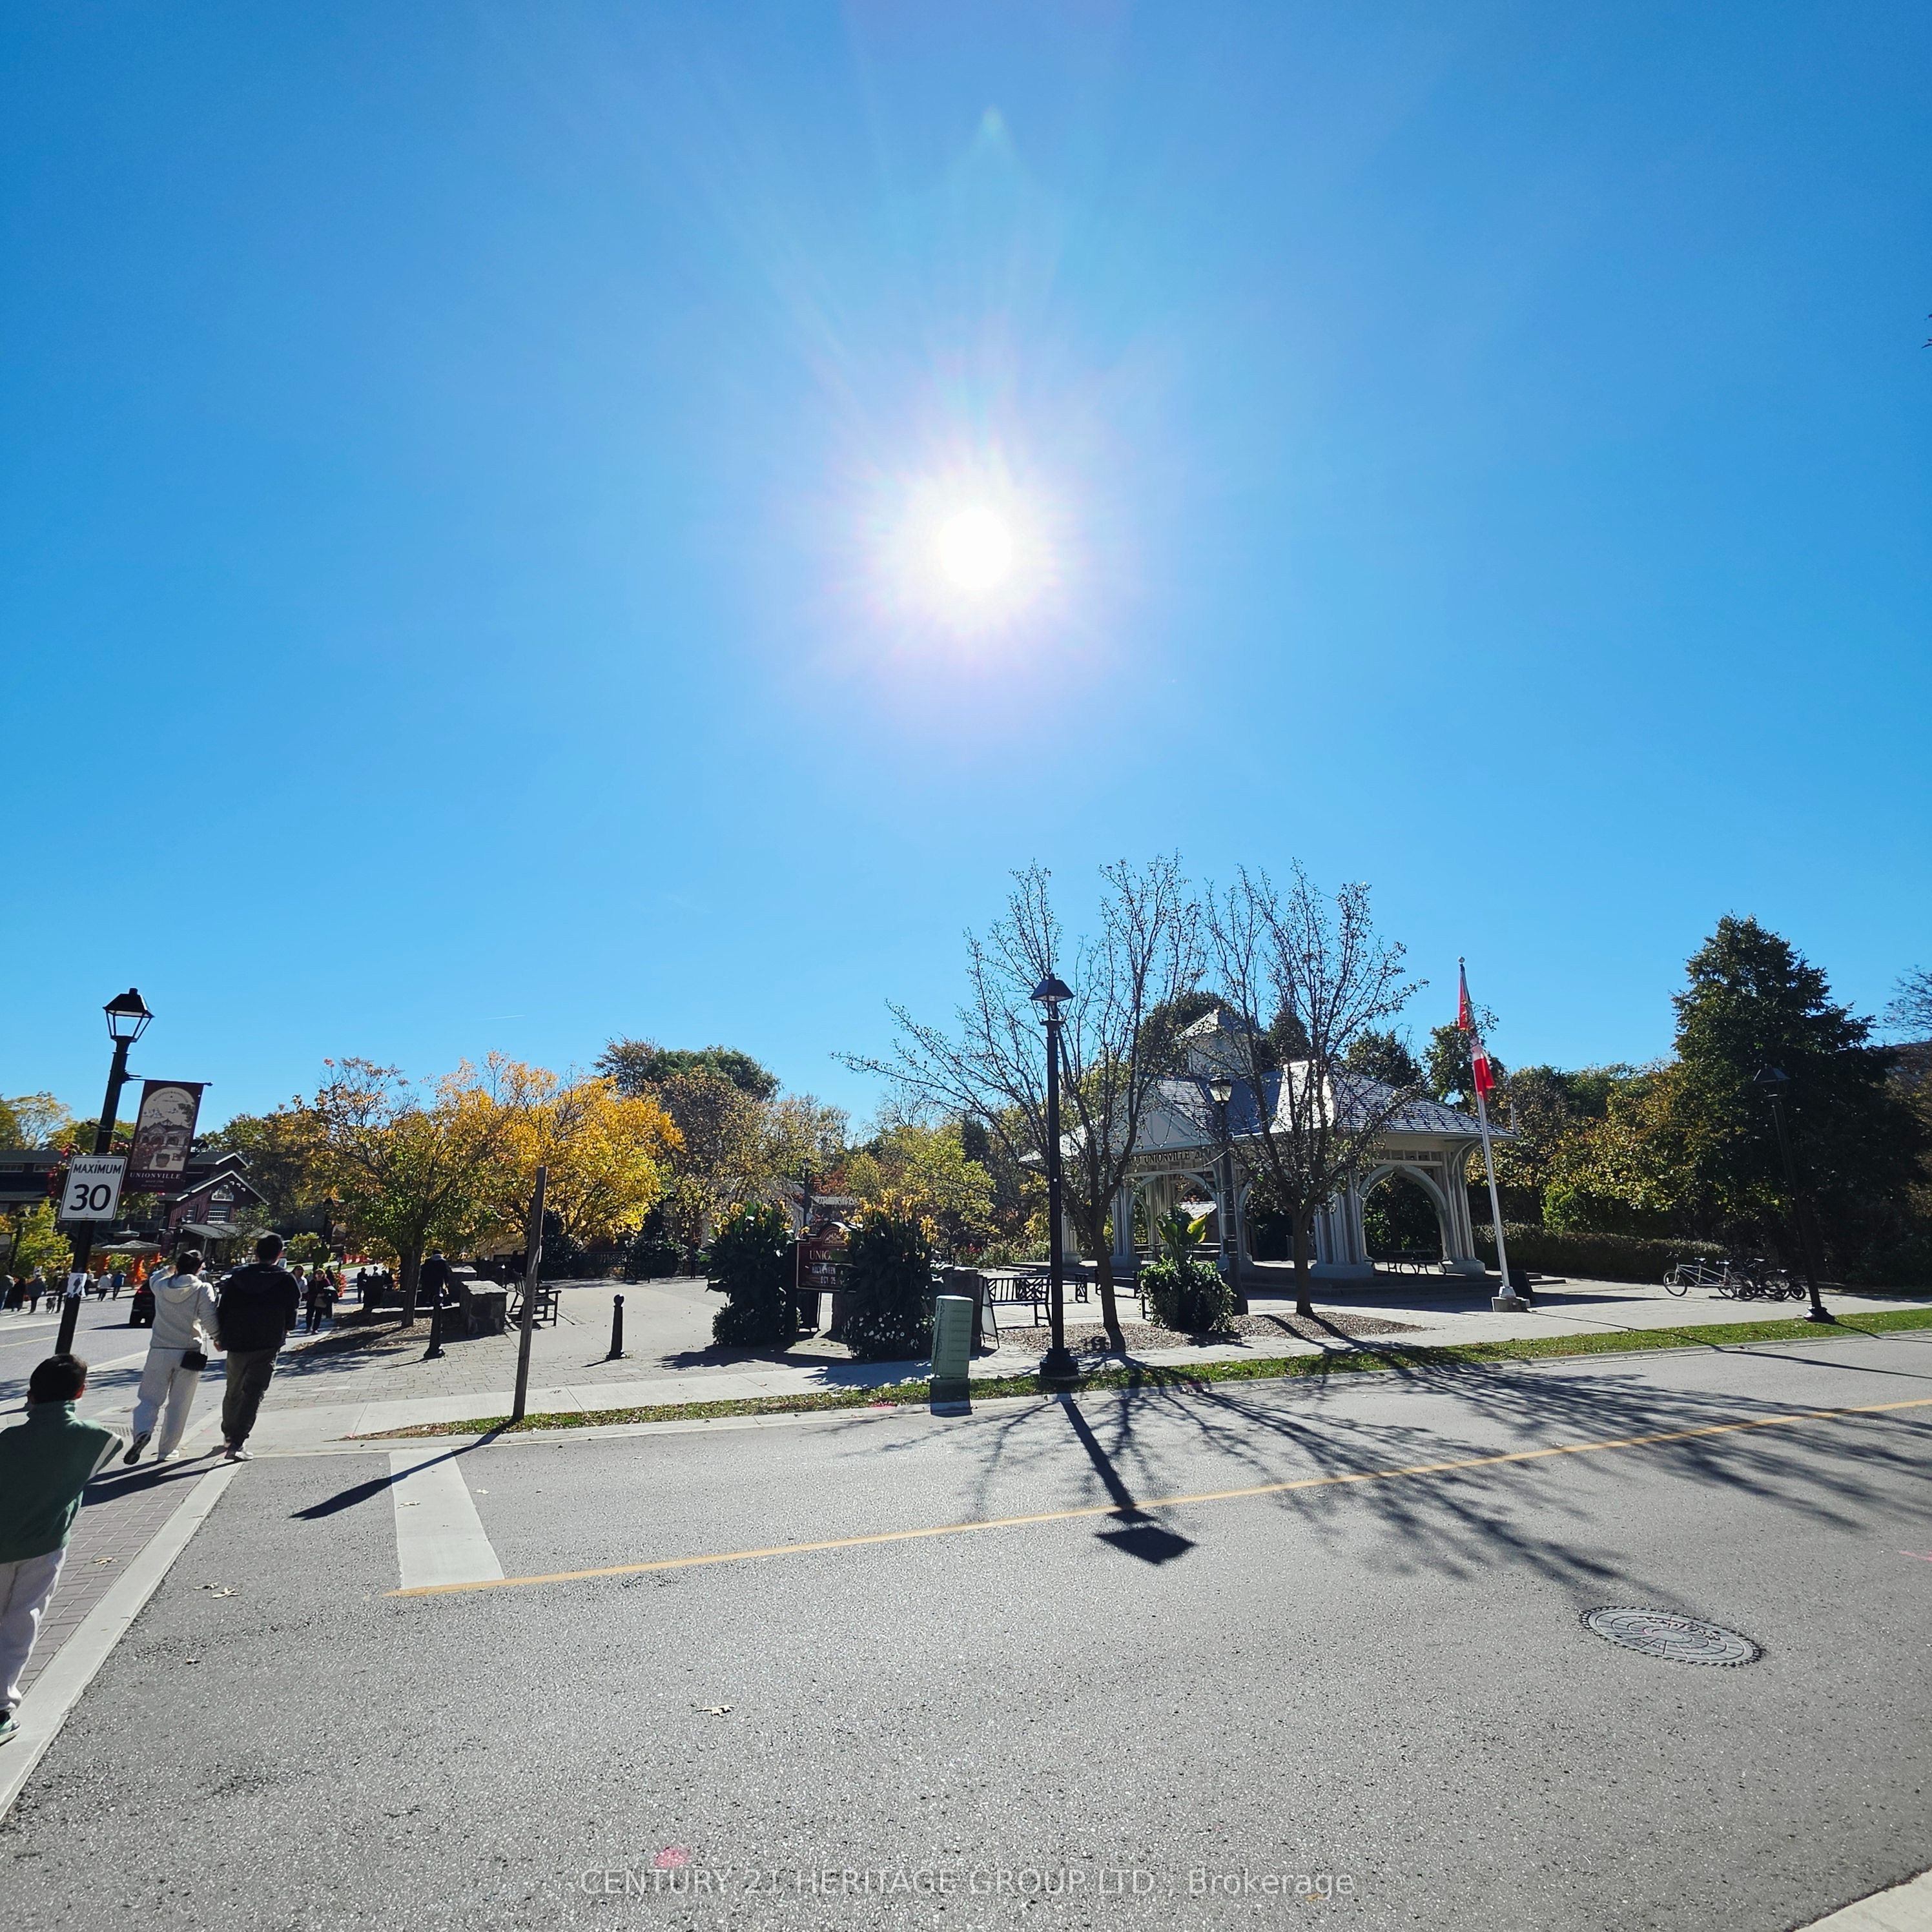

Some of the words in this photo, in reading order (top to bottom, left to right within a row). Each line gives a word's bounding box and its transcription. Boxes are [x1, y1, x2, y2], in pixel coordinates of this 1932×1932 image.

[1145, 1150, 1190, 1164] UNIONVILLE
[73, 1164, 122, 1174] MAXIMUM
[69, 1184, 111, 1211] 30
